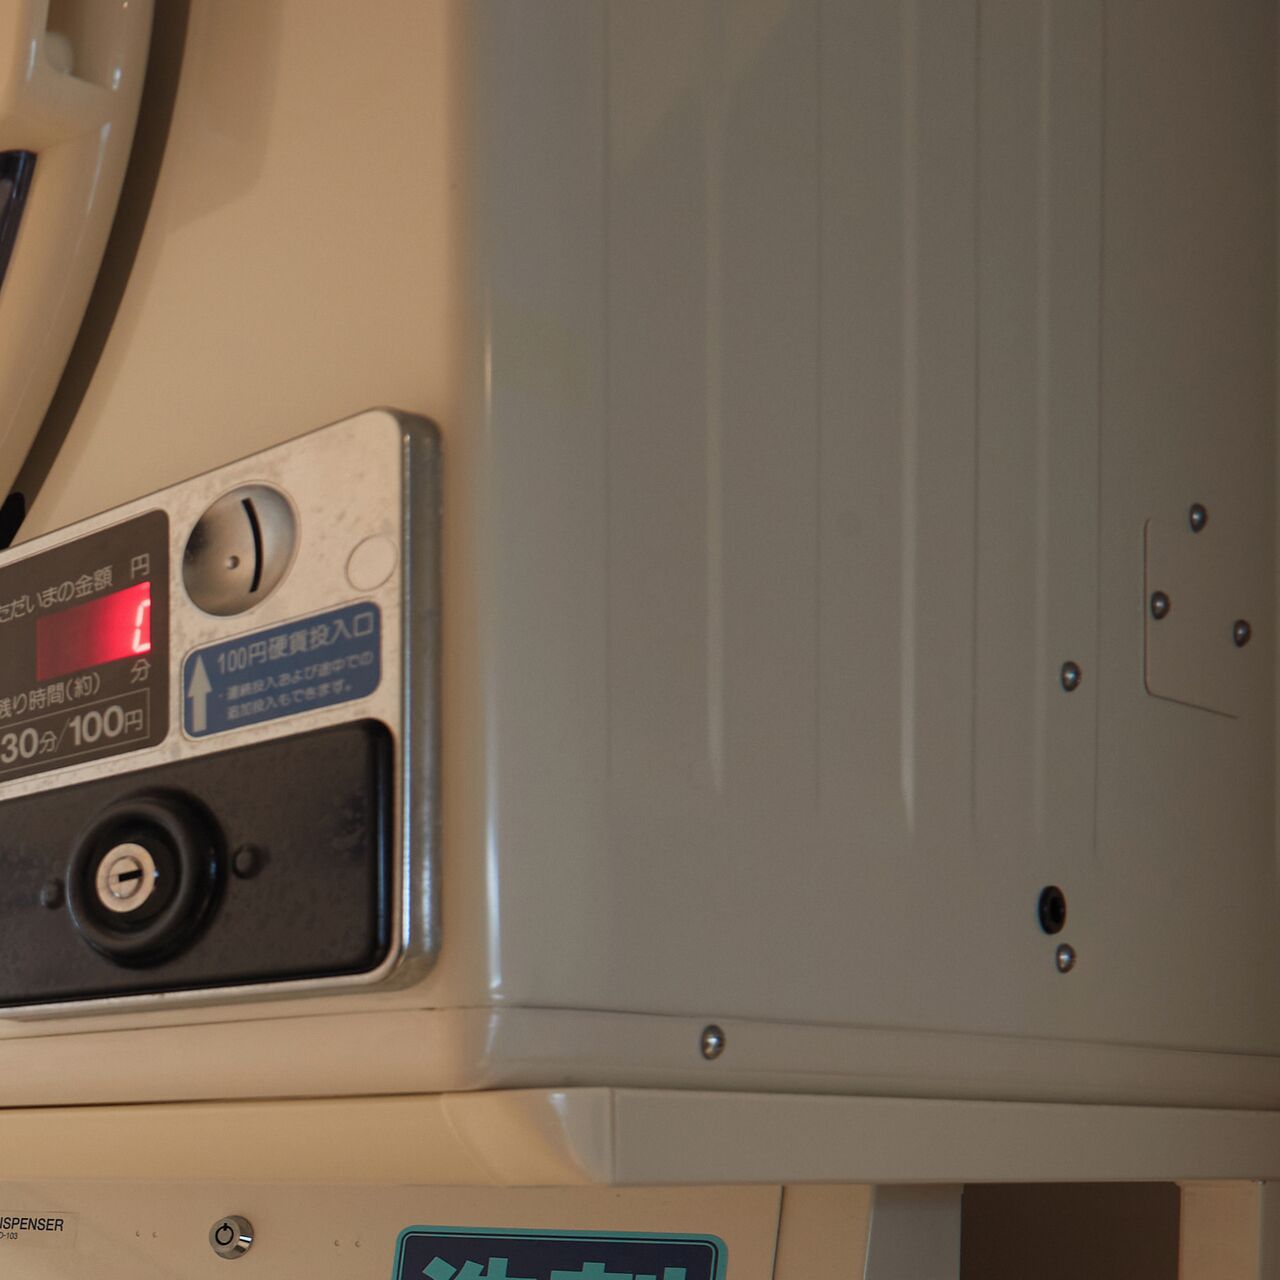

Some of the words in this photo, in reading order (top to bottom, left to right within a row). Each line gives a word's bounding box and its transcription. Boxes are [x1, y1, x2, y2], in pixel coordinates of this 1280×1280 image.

[130, 553, 151, 581] 円
[216, 611, 375, 676] 100円硬貨投入口
[130, 657, 151, 684] 分
